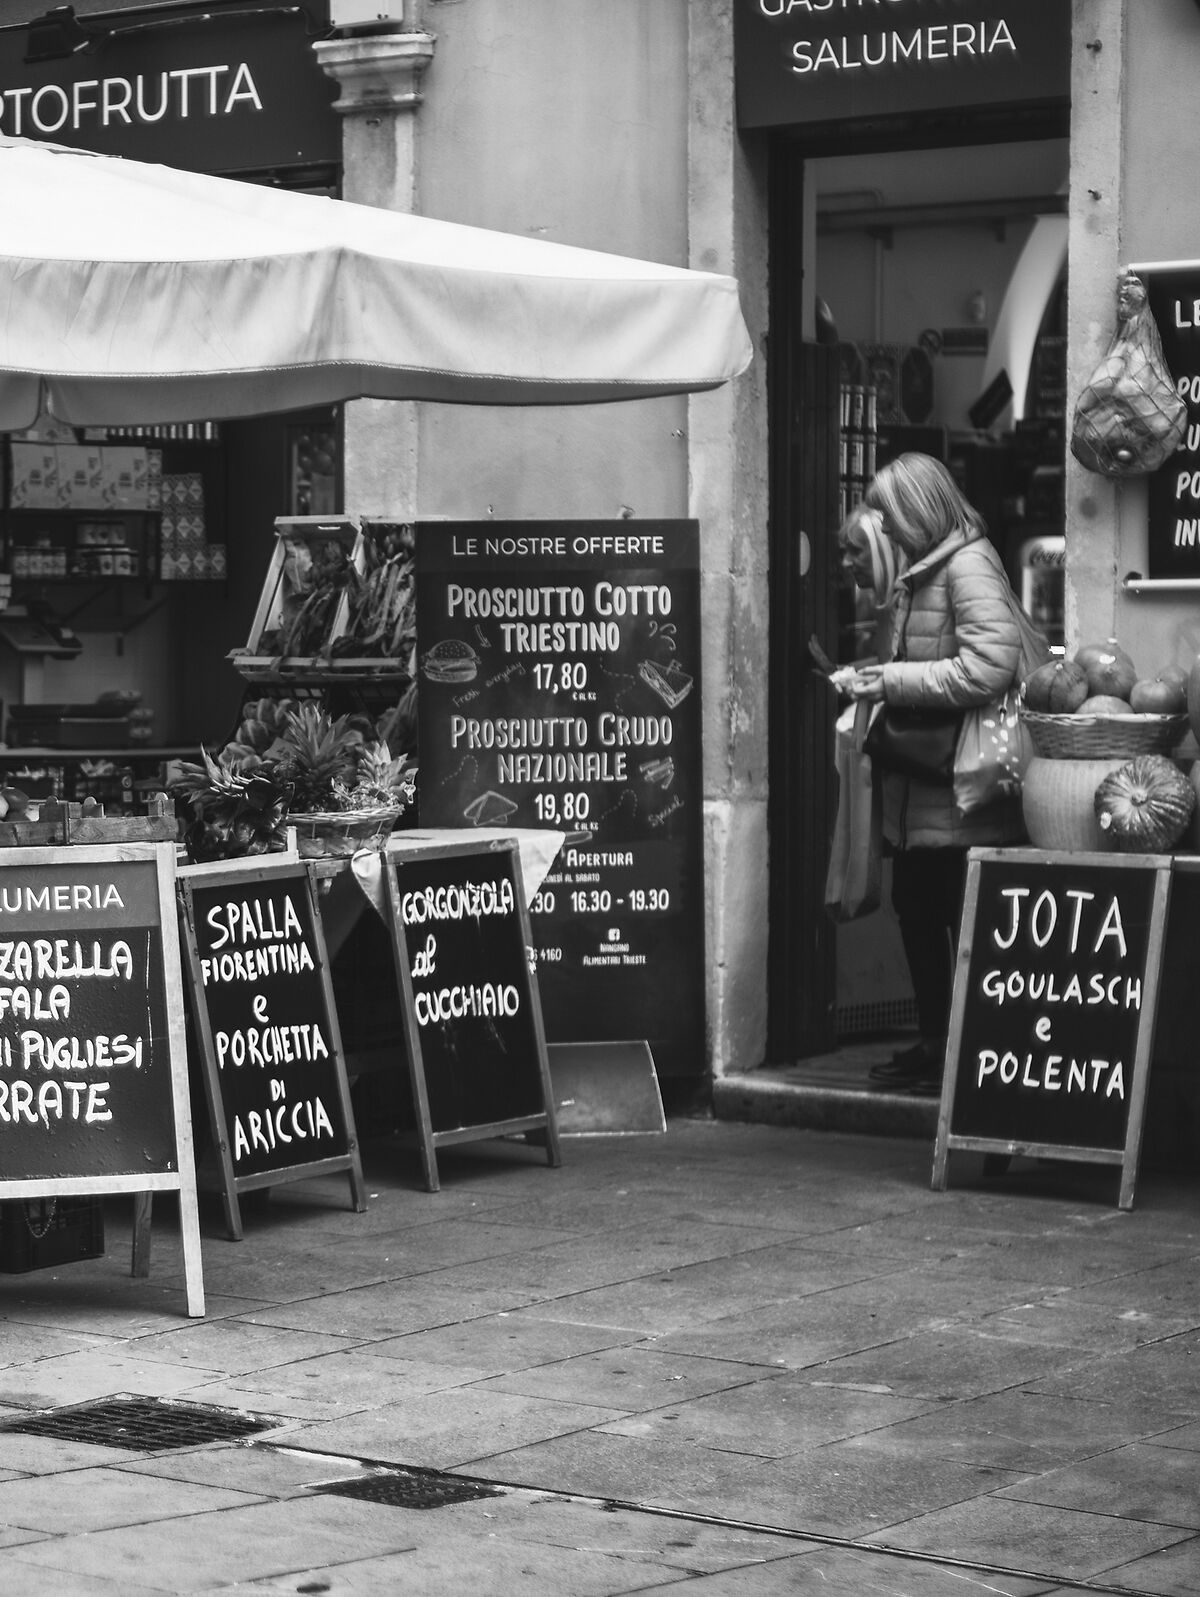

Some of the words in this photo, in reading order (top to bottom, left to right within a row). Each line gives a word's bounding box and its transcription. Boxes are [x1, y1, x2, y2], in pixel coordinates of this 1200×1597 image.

[792, 19, 1016, 73] SALUMERIA
[452, 536, 478, 555] LE
[485, 537, 567, 555] NOSTRE
[572, 536, 664, 554] OFFERTE
[447, 583, 585, 618] PROSCIUTTO
[594, 581, 672, 616] COTTO
[500, 621, 620, 653] TRIESTINO
[533, 662, 587, 694] 17,80
[450, 714, 588, 749] PROSCIUTTO
[599, 711, 673, 746] CRUDO
[497, 752, 628, 784] NAZIONALE
[534, 792, 590, 824] 19,80
[566, 849, 634, 867] APERTURA
[402, 878, 514, 926] GORGONZOLA
[570, 890, 611, 913] 16.30
[629, 888, 670, 911] 19.30
[207, 895, 302, 949] SPALLA
[993, 887, 1127, 957] JOTA
[200, 941, 315, 986] FIORENTINA
[411, 933, 437, 977] al
[253, 994, 269, 1023] e
[982, 970, 1141, 1010] GOULASCH
[216, 1024, 329, 1069] PORCHETTA
[1035, 1016, 1051, 1042] e
[21, 1030, 143, 1070] PUGLIESI
[270, 1079, 286, 1101] DI
[978, 1049, 1125, 1100] POLENTA
[234, 1096, 334, 1161] ARICCIA
